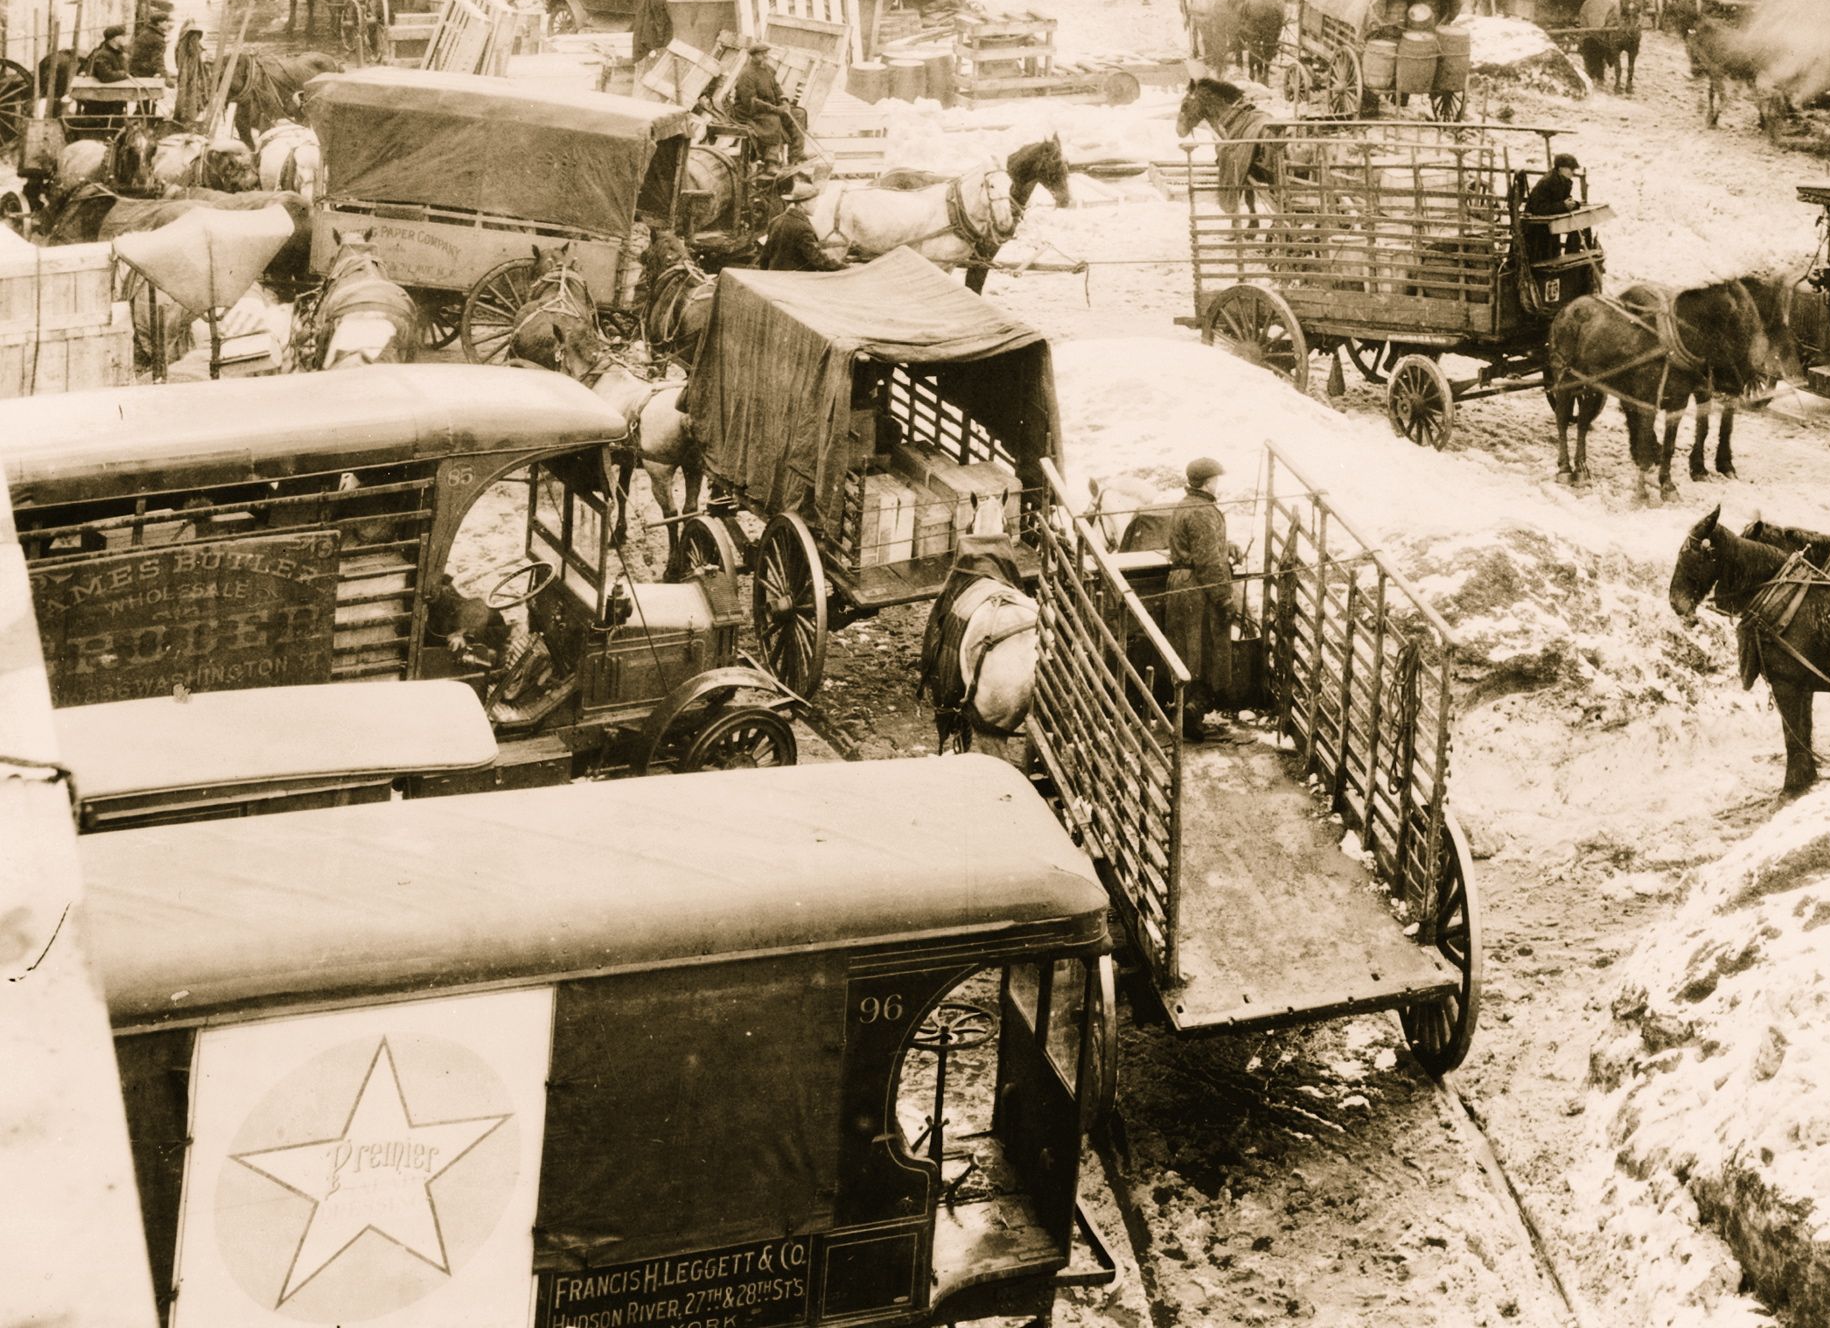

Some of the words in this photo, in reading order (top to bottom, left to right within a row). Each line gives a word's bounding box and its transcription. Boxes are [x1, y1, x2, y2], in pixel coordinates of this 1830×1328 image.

[380, 225, 417, 245] PAPER
[418, 230, 463, 264] COMPANY
[447, 468, 474, 487] 85
[46, 558, 161, 614] AMES
[173, 551, 323, 585] BUTLER
[104, 583, 249, 616] WHOLESALE
[134, 657, 289, 698] WASHINGTON
[858, 993, 904, 1025] 96
[326, 1138, 441, 1201] Premier
[555, 1271, 640, 1310] FRANCIS
[643, 1262, 663, 1294] H.
[664, 1248, 756, 1287] LEGGETT
[758, 1243, 776, 1273] &
[780, 1239, 808, 1270] CO.
[723, 1286, 735, 1309] &
